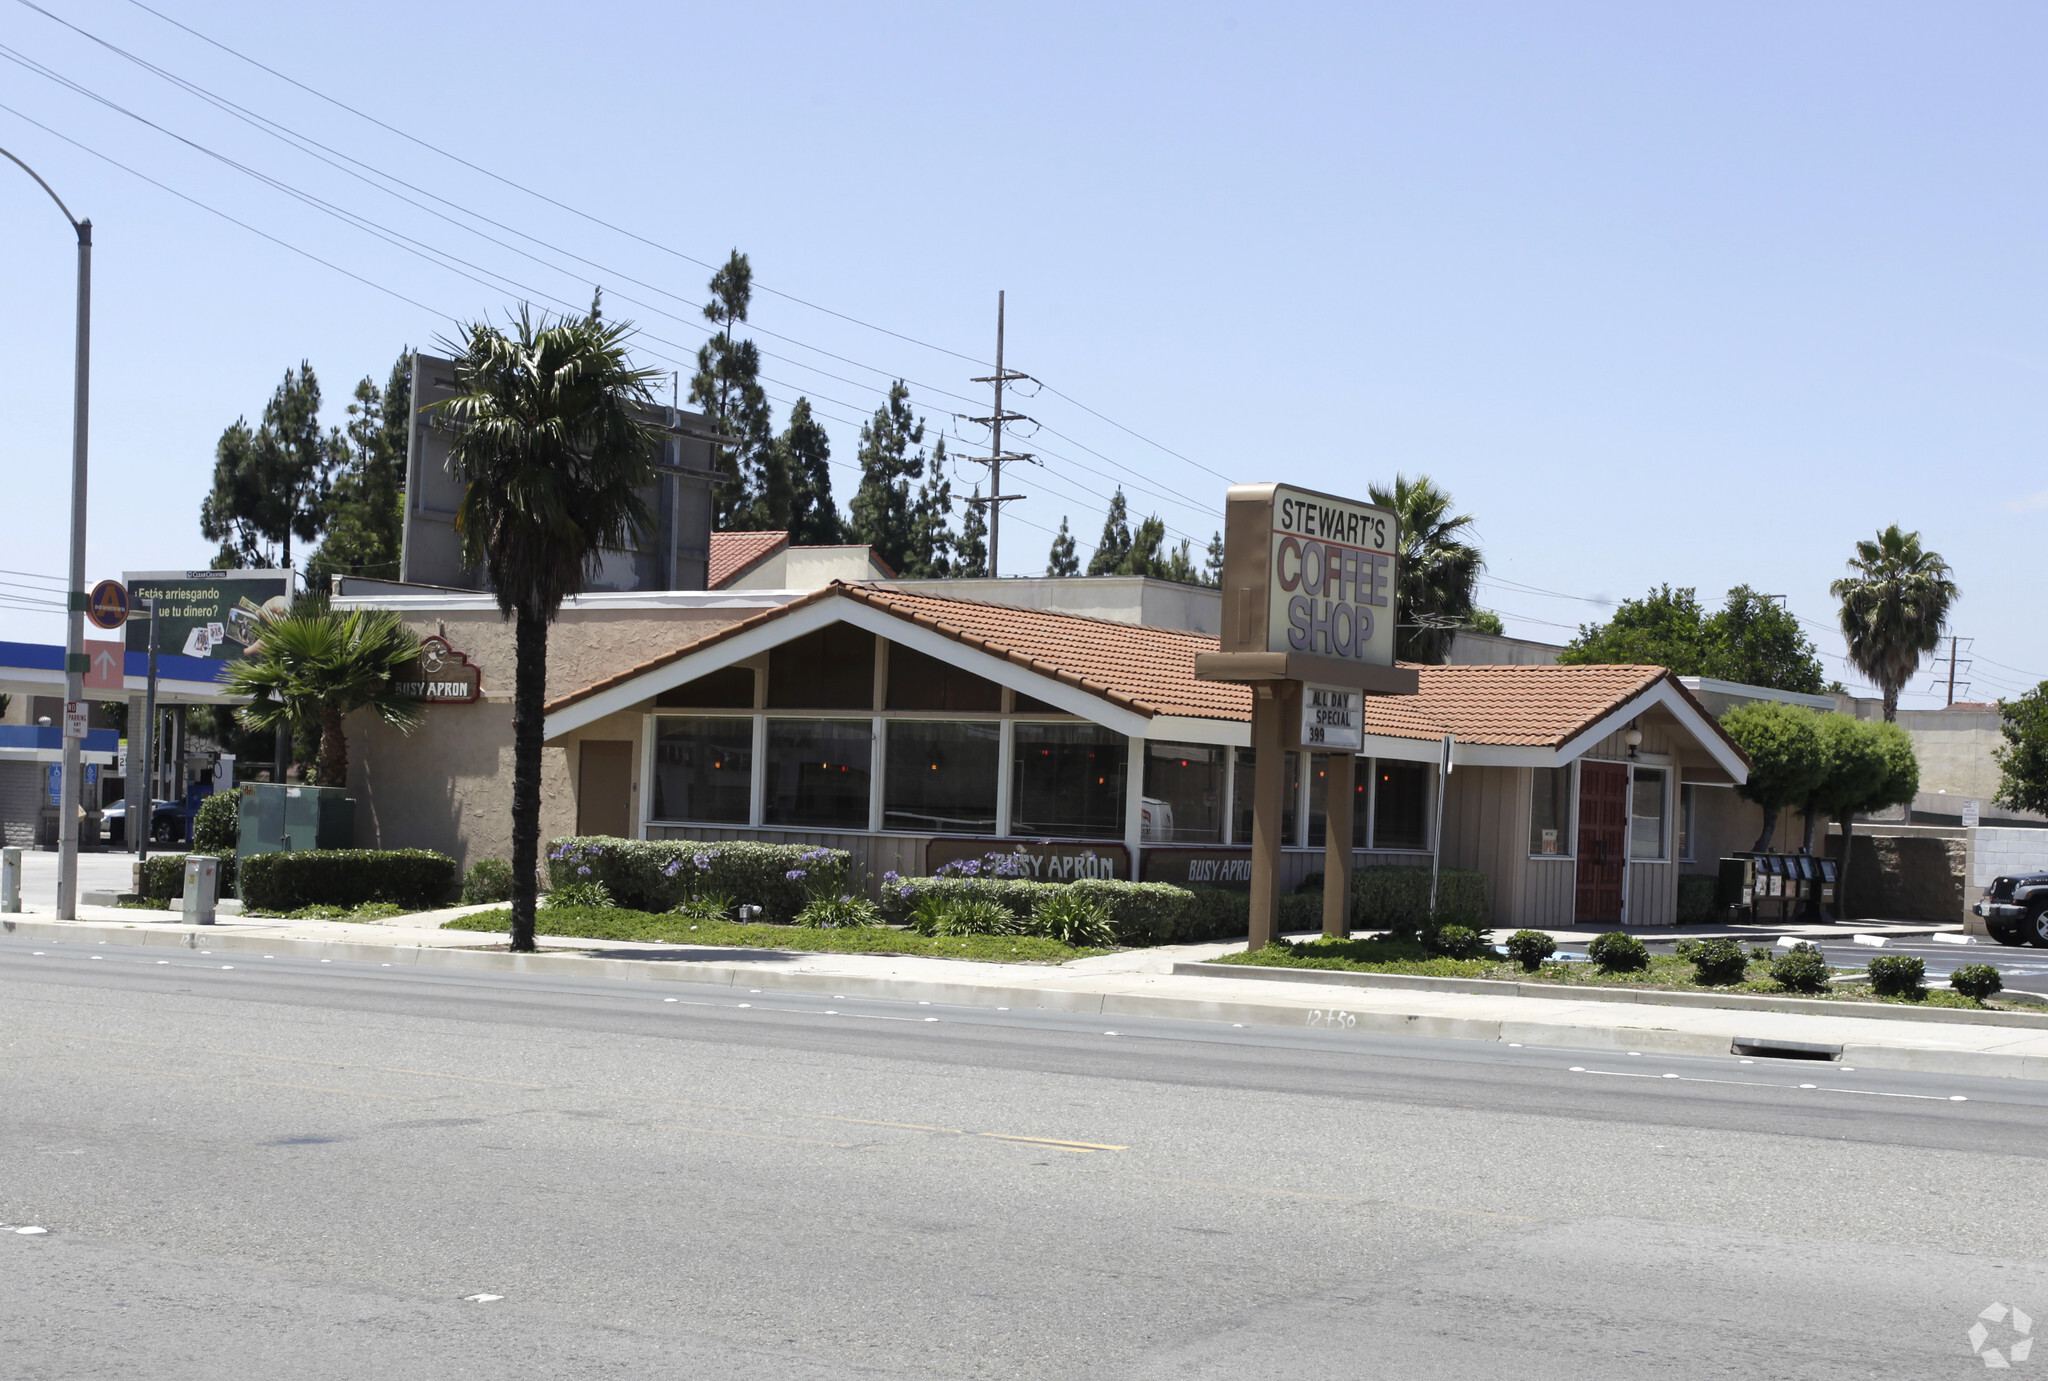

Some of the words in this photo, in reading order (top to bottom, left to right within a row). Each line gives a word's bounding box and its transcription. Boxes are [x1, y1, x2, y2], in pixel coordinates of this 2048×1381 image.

[1281, 498, 1386, 549] STEWART'S
[1277, 536, 1389, 608] COFFEE
[165, 587, 220, 602] arriesgando
[94, 604, 126, 612] DOWNTOWN
[172, 606, 181, 617] tu
[183, 605, 219, 617] dinero?
[1287, 595, 1375, 658] SHOP
[427, 682, 468, 697] APRON
[67, 703, 76, 712] NO
[1312, 691, 1328, 707] ALL
[1331, 692, 1349, 709] DAY
[1316, 710, 1351, 727] SPECIAL
[1309, 727, 1325, 743] 399
[994, 853, 1044, 877] BUSY
[1047, 855, 1114, 880] APRON
[1188, 859, 1221, 881] BUSY
[1219, 859, 1252, 881] APRO
